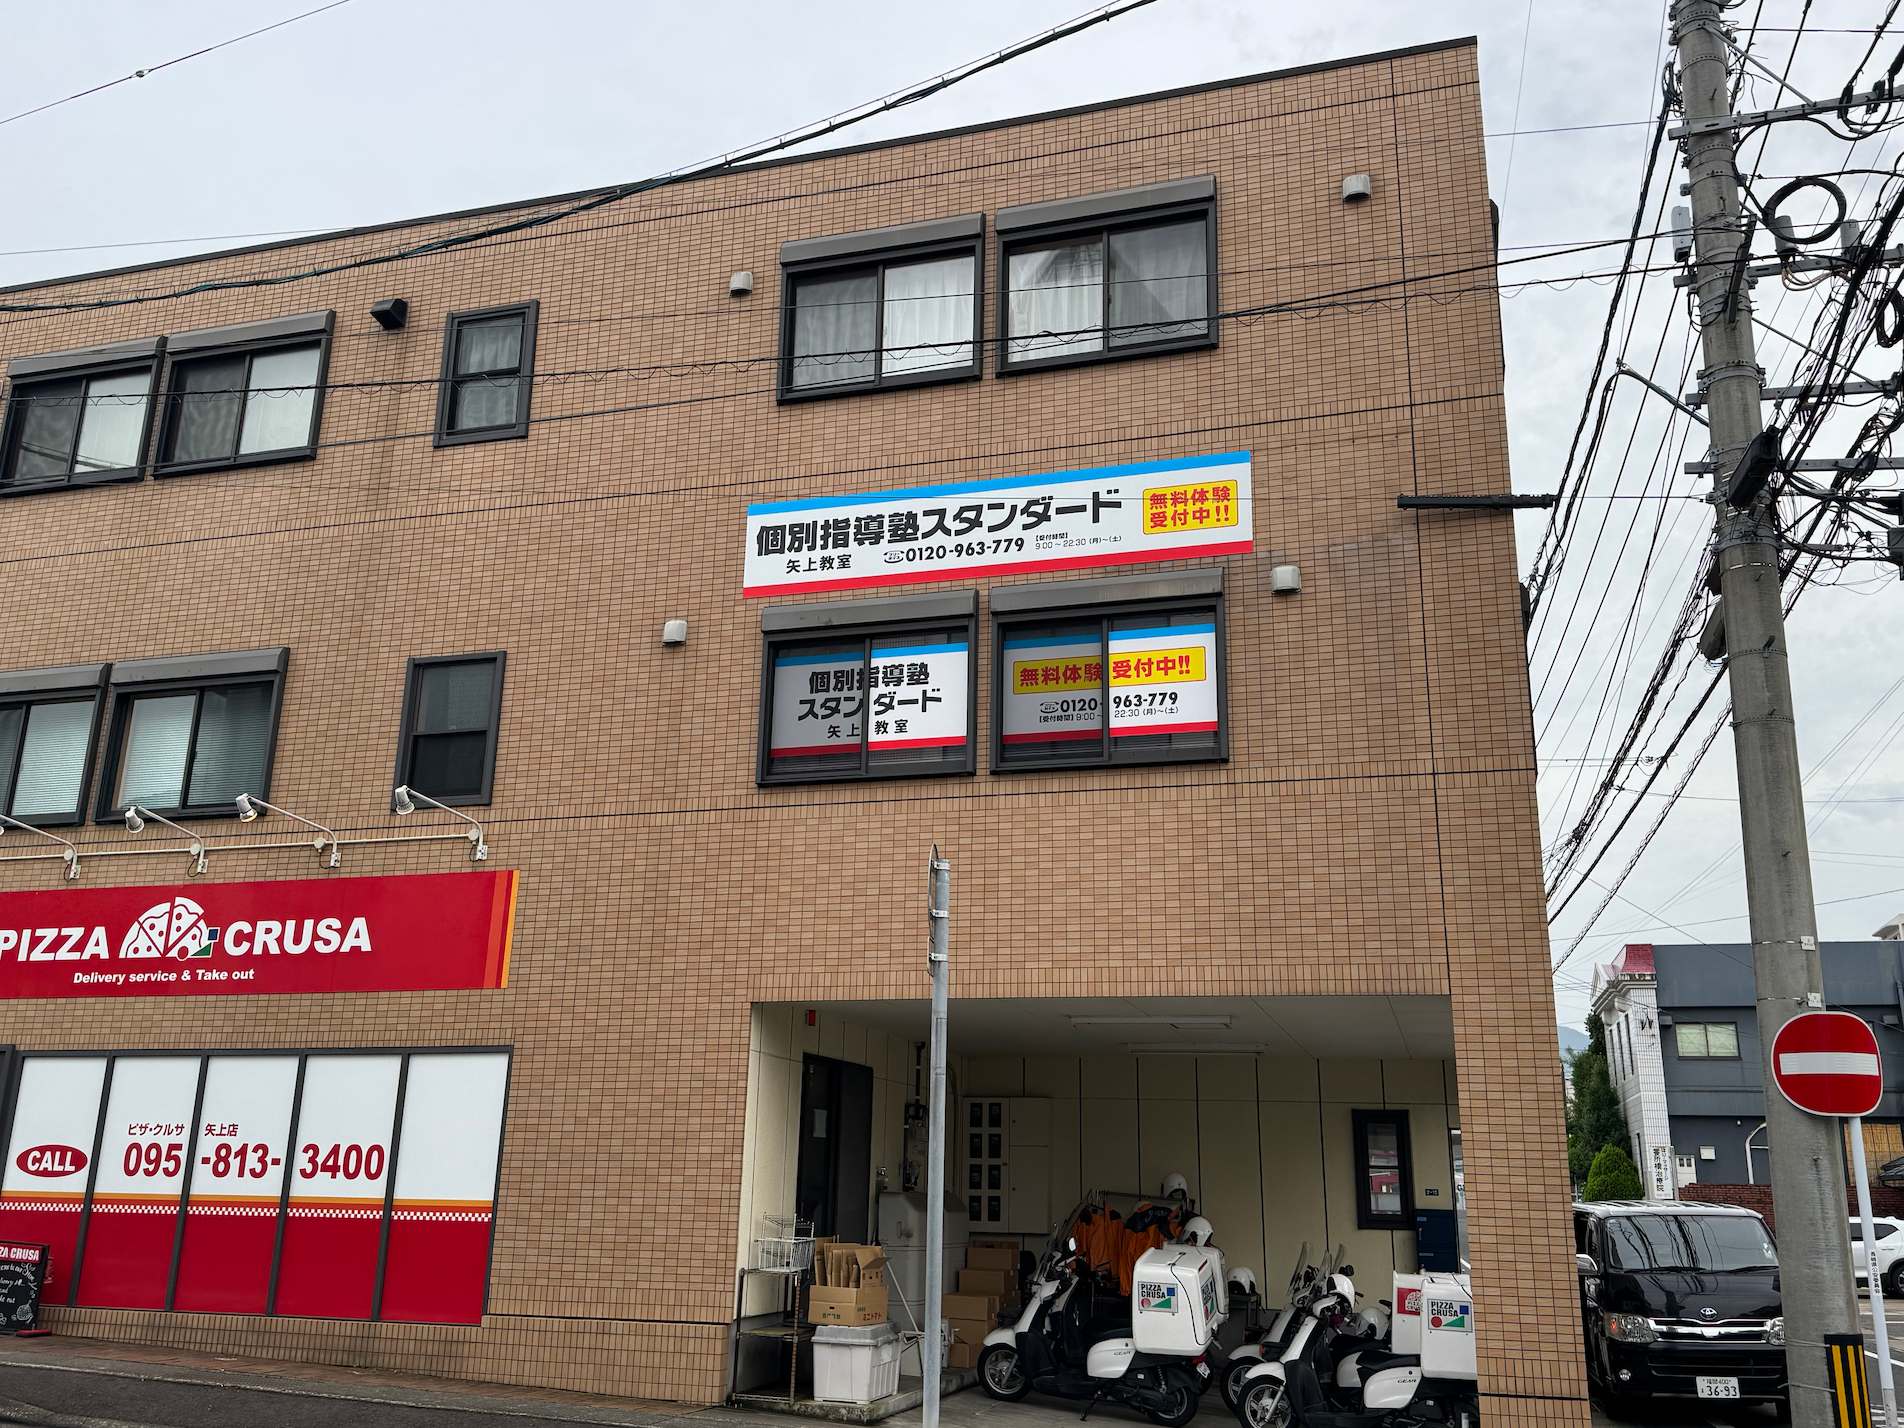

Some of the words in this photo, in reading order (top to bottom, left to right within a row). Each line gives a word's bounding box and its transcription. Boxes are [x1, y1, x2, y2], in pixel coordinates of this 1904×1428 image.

[1149, 485, 1232, 510] 無料体験
[756, 489, 1122, 557] 個別指導塾スタンダード
[1149, 504, 1230, 529] 受付中!!
[905, 537, 1025, 562] 0120-963-779
[785, 553, 852, 574] 矢上教室
[797, 688, 942, 722] スタンダード
[827, 718, 908, 739] 矢上教室
[0, 926, 110, 962] PIZZA
[223, 916, 373, 956] CRUSA
[73, 971, 126, 985] Delivery
[128, 970, 178, 983] service
[180, 969, 192, 982] &
[195, 968, 230, 982] Take
[231, 968, 256, 981] out
[127, 1123, 185, 1137] ピザ・クルサ
[204, 1123, 239, 1137] 矢上店
[27, 1150, 76, 1172] CALL
[122, 1142, 184, 1178] 095
[299, 1143, 385, 1181] 3400
[10, 1248, 40, 1261] CRUSA
[1140, 1283, 1162, 1292] PIZZA
[1430, 1301, 1454, 1310] PIZZA
[1430, 1308, 1459, 1317] CRUSA
